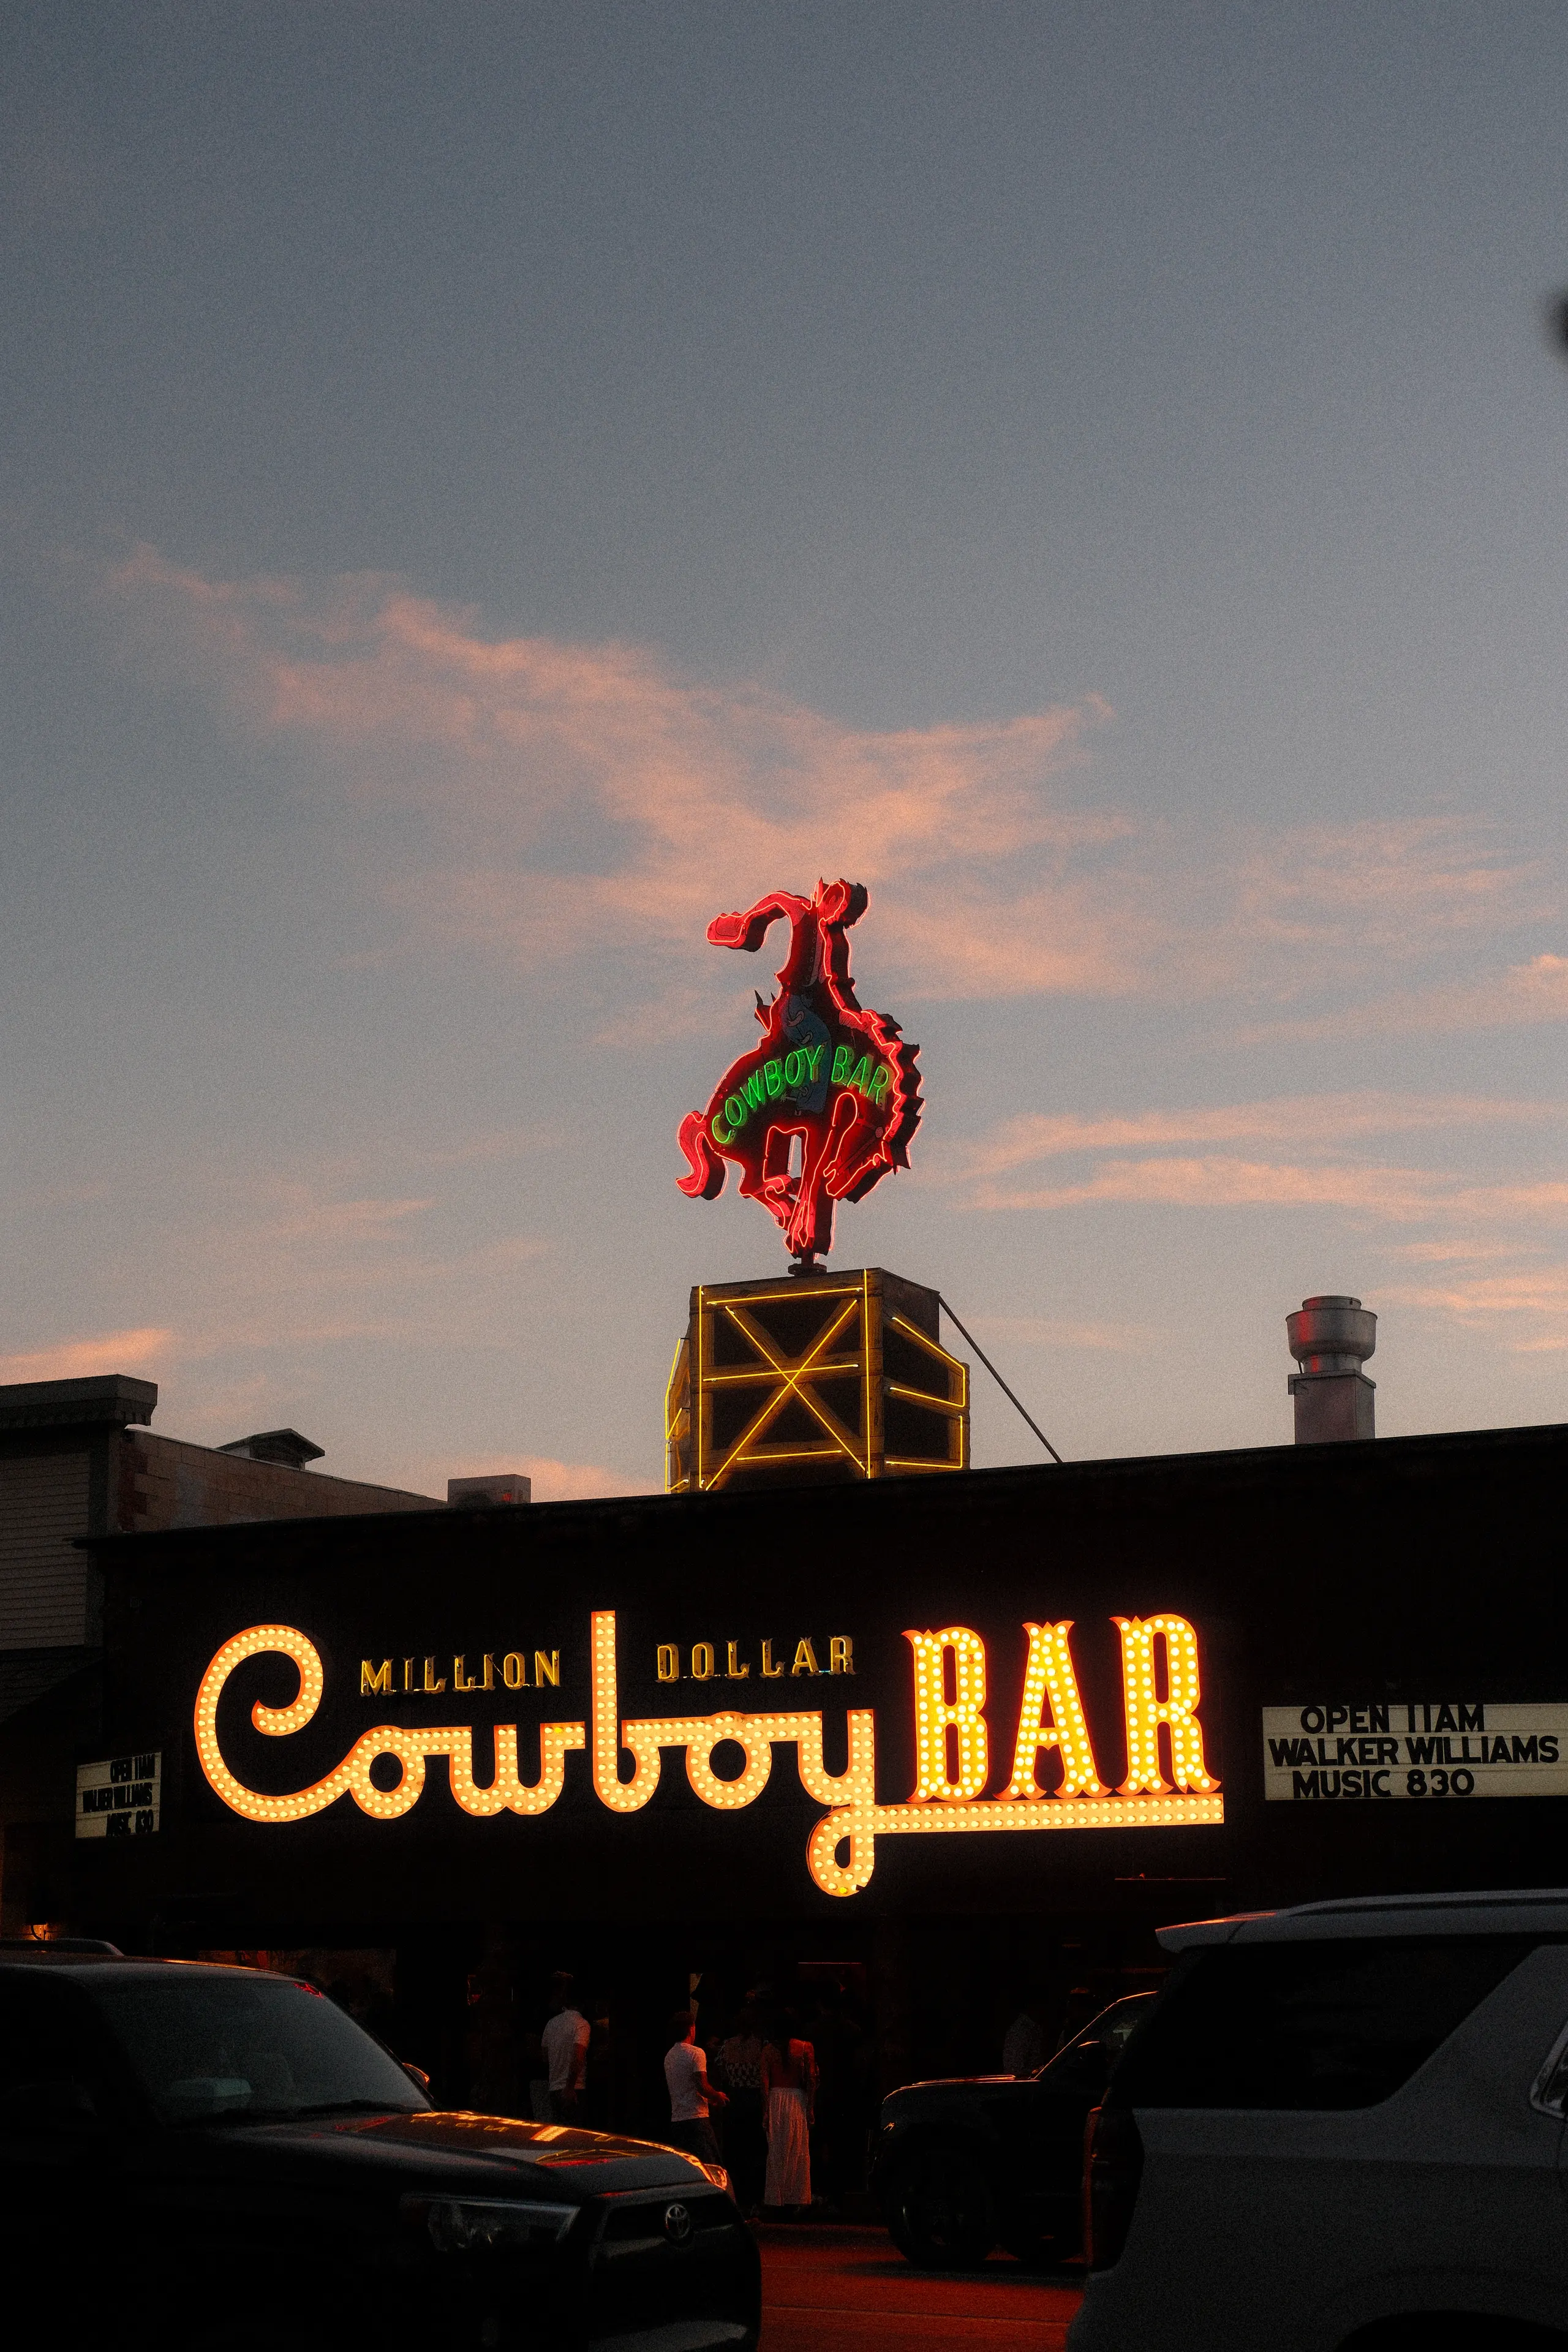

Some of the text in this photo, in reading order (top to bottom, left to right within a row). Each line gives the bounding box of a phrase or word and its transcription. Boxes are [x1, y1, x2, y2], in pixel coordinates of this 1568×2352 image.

[712, 1044, 897, 1145] COWBOY BAR
[360, 1635, 856, 1697] MILLION DOLLAR
[1300, 1704, 1485, 1734] OPEN 11AM
[194, 1610, 1221, 1898] Cowboy BAR
[1268, 1735, 1559, 1766] WALKER WILLIAMS
[1292, 1769, 1474, 1799] MUSIC 830
